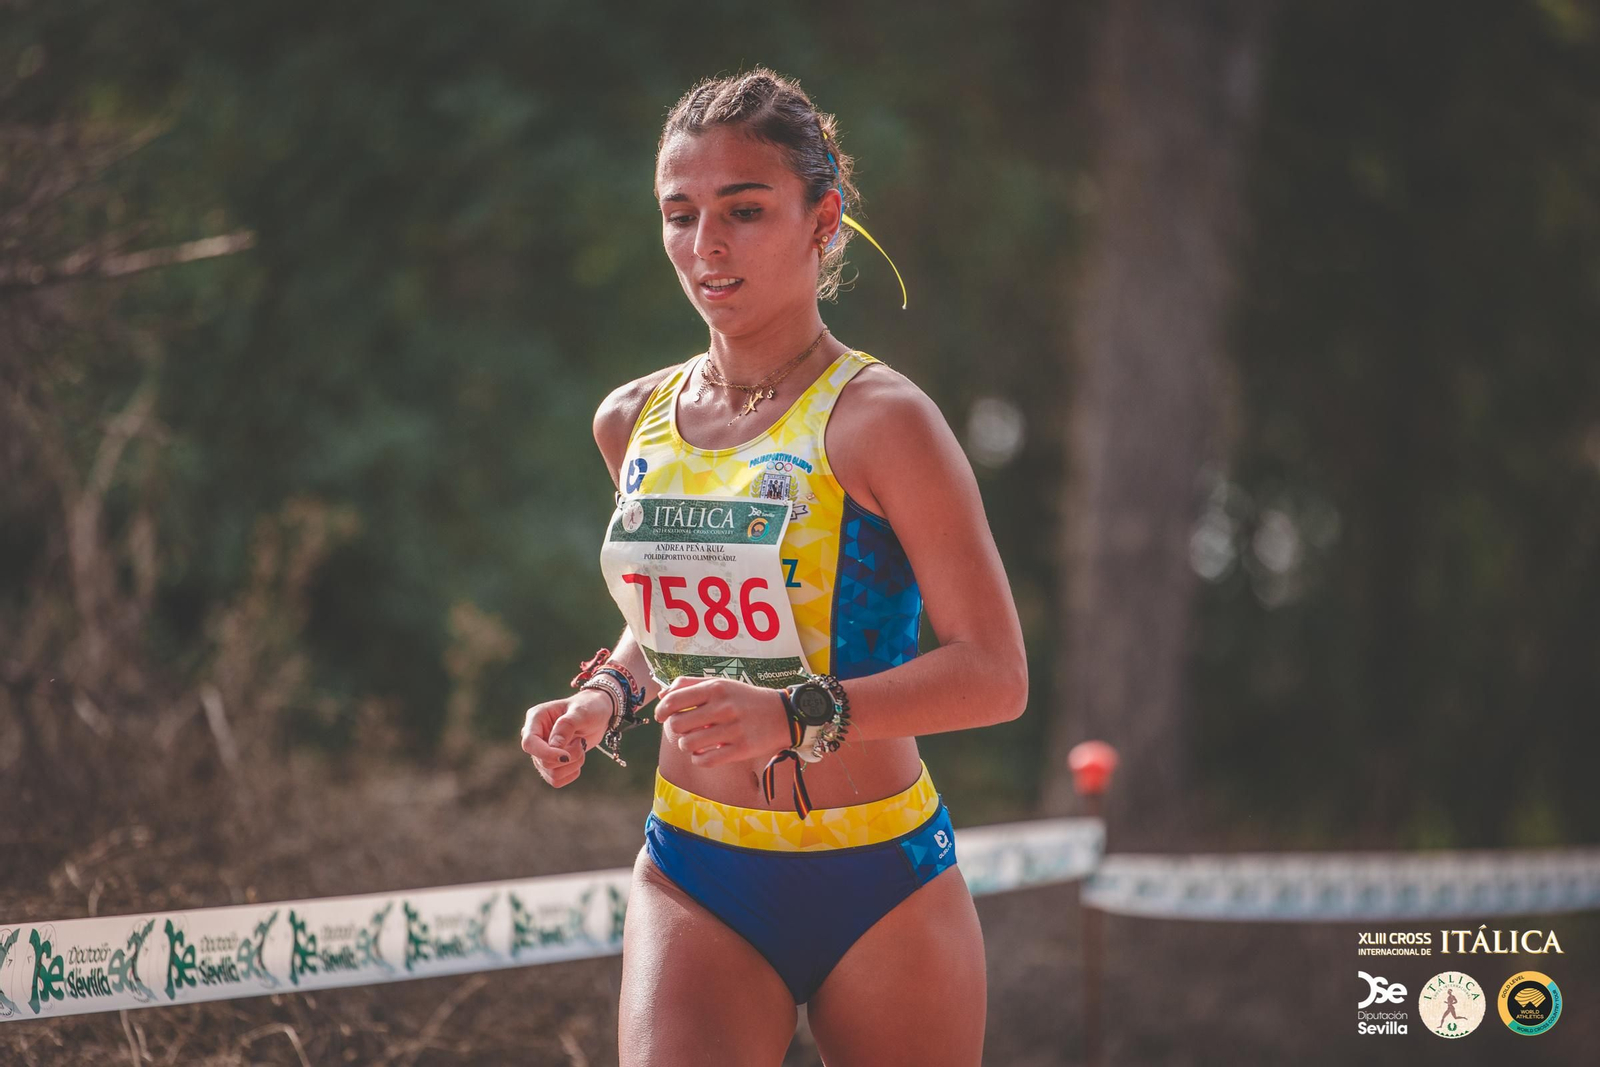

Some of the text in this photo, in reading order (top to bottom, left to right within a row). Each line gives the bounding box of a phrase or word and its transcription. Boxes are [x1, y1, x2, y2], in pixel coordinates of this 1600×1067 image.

[749, 452, 812, 474] POLIDEPORTIVO OLIMPO
[653, 501, 735, 530] ITÁLICA
[643, 553, 692, 561] POLIDEPORTIVO
[717, 554, 737, 562] CÁDIZ
[655, 543, 725, 553] ANDREA PEÑA RUIZ
[621, 573, 780, 642] 7586
